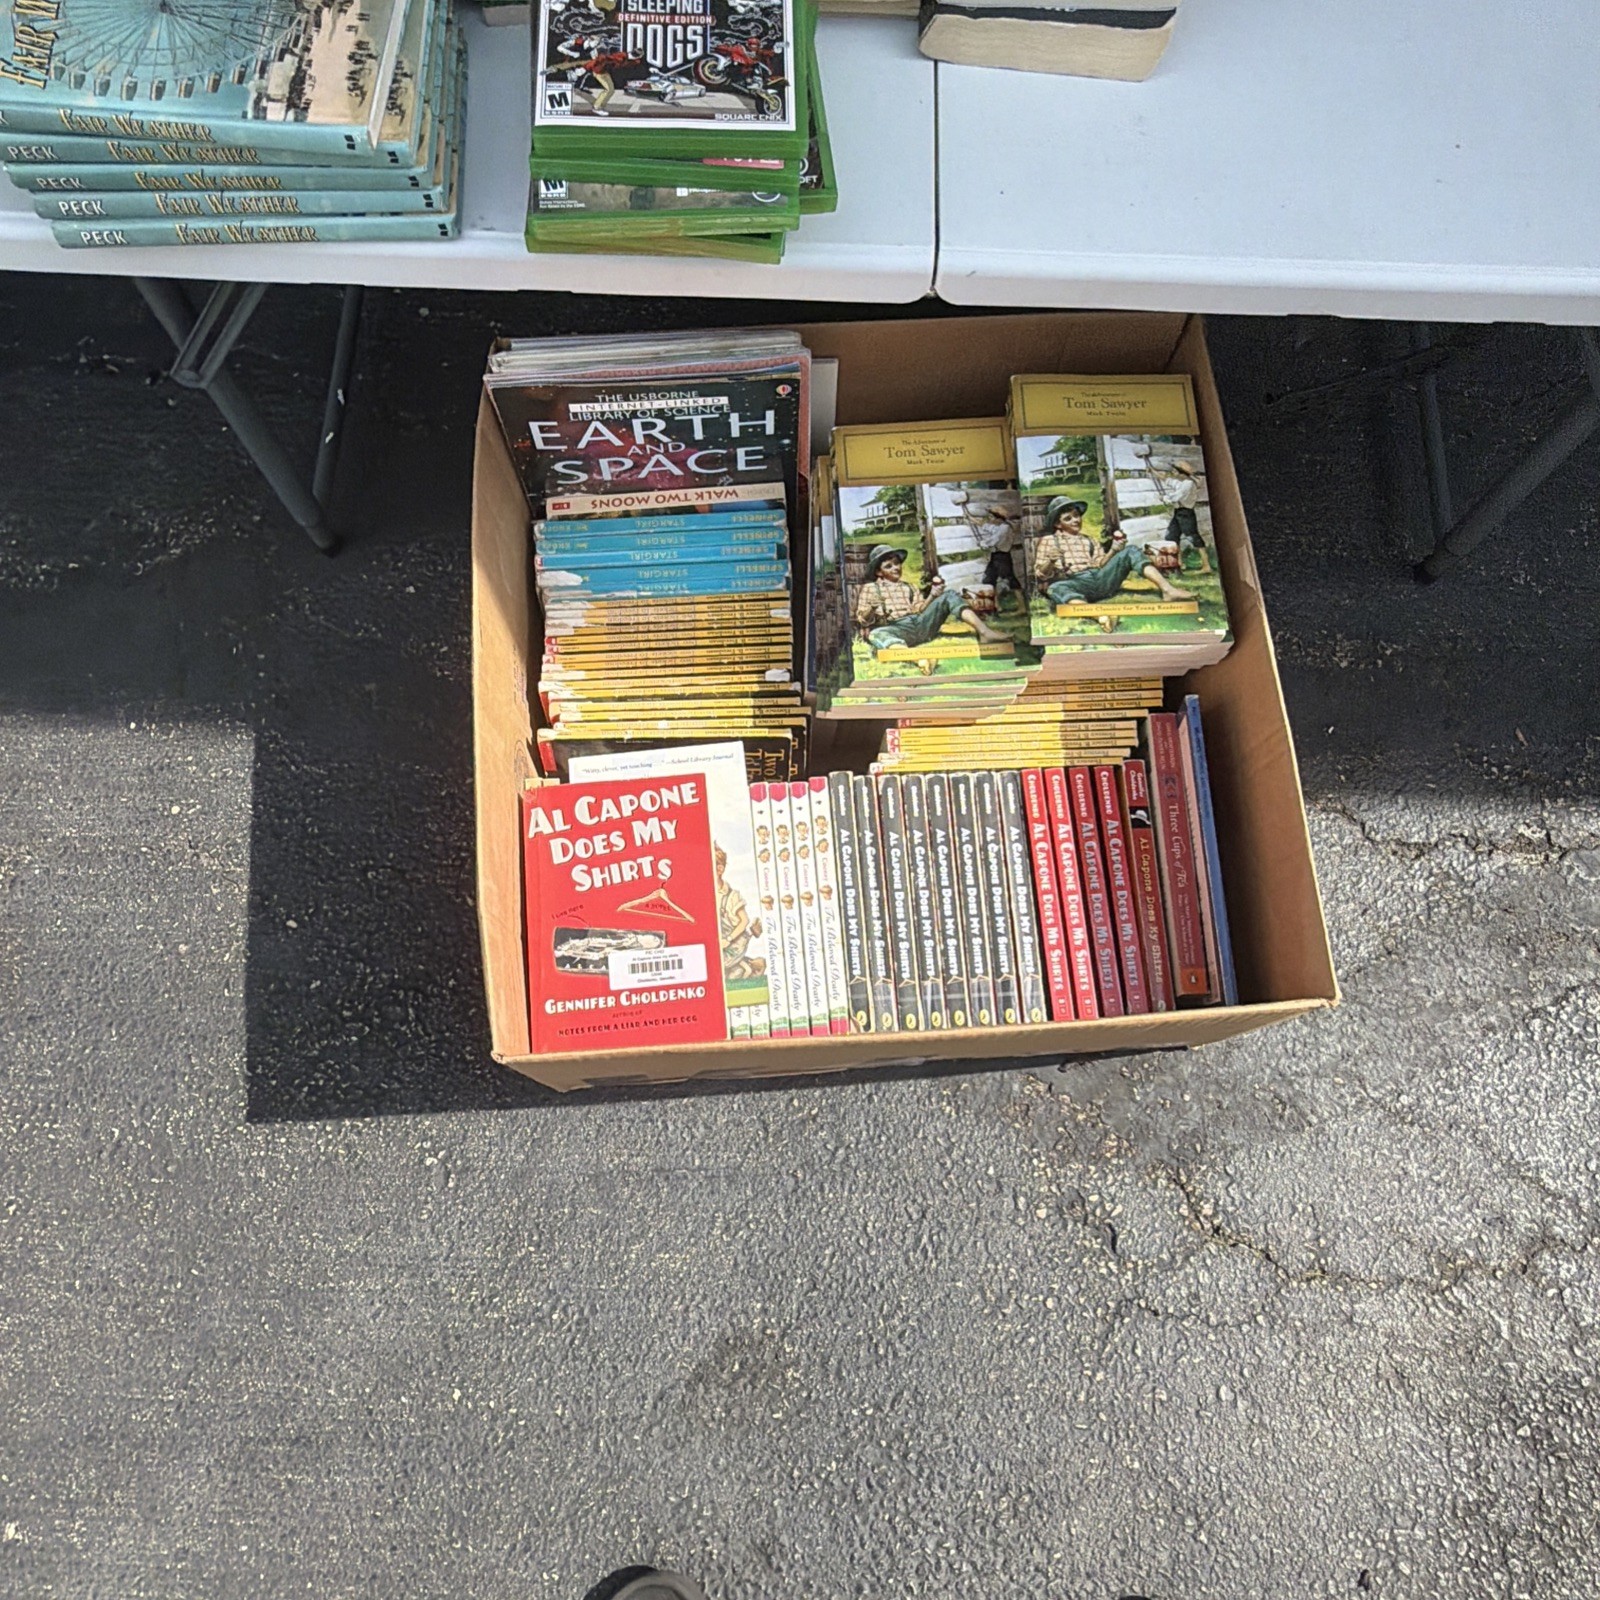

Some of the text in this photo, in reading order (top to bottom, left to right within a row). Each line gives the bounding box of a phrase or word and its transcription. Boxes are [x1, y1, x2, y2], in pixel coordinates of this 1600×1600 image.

[618, 13, 712, 24] DEFINITIVE EDITION
[628, 0, 704, 14] SLEEPING
[626, 23, 704, 68] DOGS
[548, 92, 570, 109] M
[58, 107, 216, 143] FAIR WEATHER
[714, 113, 758, 121] SQUARE
[7, 140, 261, 164] PECK FAIR WEATHER
[36, 169, 282, 190] PECK FAIR WEATHER
[58, 190, 302, 216] PECK FAIR WEATHER
[80, 221, 320, 246] PECK FAIR WEATHER
[579, 398, 721, 411] INTERNET-LINKED
[595, 390, 700, 402] THE USBORNE
[1062, 397, 1147, 410] Tom Sawyer
[568, 404, 731, 422] LIBRARY OF SCIENCE
[528, 410, 775, 450] EARTH
[628, 442, 686, 456] AND
[884, 444, 965, 458] Tom Sawyer
[554, 446, 768, 485] SPACE
[591, 494, 650, 509] MOONS
[654, 492, 691, 504] TWO
[694, 488, 739, 502] WALK
[636, 518, 686, 528] STARGIRL
[637, 535, 686, 546] STARGIRL
[631, 550, 678, 560] STARGIRL
[638, 564, 784, 578] SPINELLI STARGIRL
[528, 782, 701, 838] AL CAPONE
[1169, 803, 1180, 832] Three
[550, 816, 678, 865] DOES MY
[1010, 826, 1020, 841] AL
[1033, 823, 1045, 839] AL
[1058, 823, 1070, 840] AL
[1081, 822, 1093, 838] AL
[1106, 820, 1119, 836] AL
[1110, 838, 1125, 886] CAPONE
[1172, 835, 1185, 863] Cups
[570, 856, 672, 892] SHIRTS
[1012, 843, 1024, 884] CAPONE
[1036, 842, 1051, 890] CAPONE
[1060, 842, 1076, 891] CAPONE
[1084, 841, 1099, 890] CAPONE
[1142, 855, 1152, 892] Capone
[1178, 868, 1188, 888] Tea
[840, 828, 861, 976] AL CAPONE DOES MY SHIRTS
[936, 828, 958, 975] AL CAPONE DOES MY SHIRTS
[961, 827, 983, 974] AL CAPONE DOES MY SHIRTS
[986, 827, 1009, 973] AL CAPONE DOES MY SHIRTS
[1017, 886, 1027, 914] DOES
[1042, 894, 1054, 924] DOES
[1068, 894, 1079, 925] DOES
[1092, 894, 1103, 923] DOES
[1117, 890, 1128, 920] DOES
[1146, 896, 1156, 922] Does
[1020, 916, 1030, 933] MY
[1047, 927, 1059, 945] MY
[1072, 928, 1084, 946] MY
[1096, 926, 1108, 944] MY
[1121, 923, 1133, 941] MY
[768, 937, 778, 976] Beloved
[788, 936, 798, 975] Beloved
[808, 933, 817, 972] Beloved
[826, 928, 836, 966] Beloved
[1022, 936, 1035, 972] SHIRTS
[1050, 949, 1064, 990] SHIRTS
[1076, 950, 1089, 990] SHIRTS
[1100, 948, 1113, 989] SHIRTS
[1125, 945, 1138, 986] SHIRTS
[1152, 945, 1163, 983] Shirts
[544, 986, 706, 1014] GENNIFER CHOLDENKO
[558, 1027, 585, 1036] NOTES
[588, 1024, 610, 1034] FROM
[621, 1020, 640, 1030] LIAR
[642, 1018, 660, 1027] AND
[662, 1016, 678, 1026] HER
